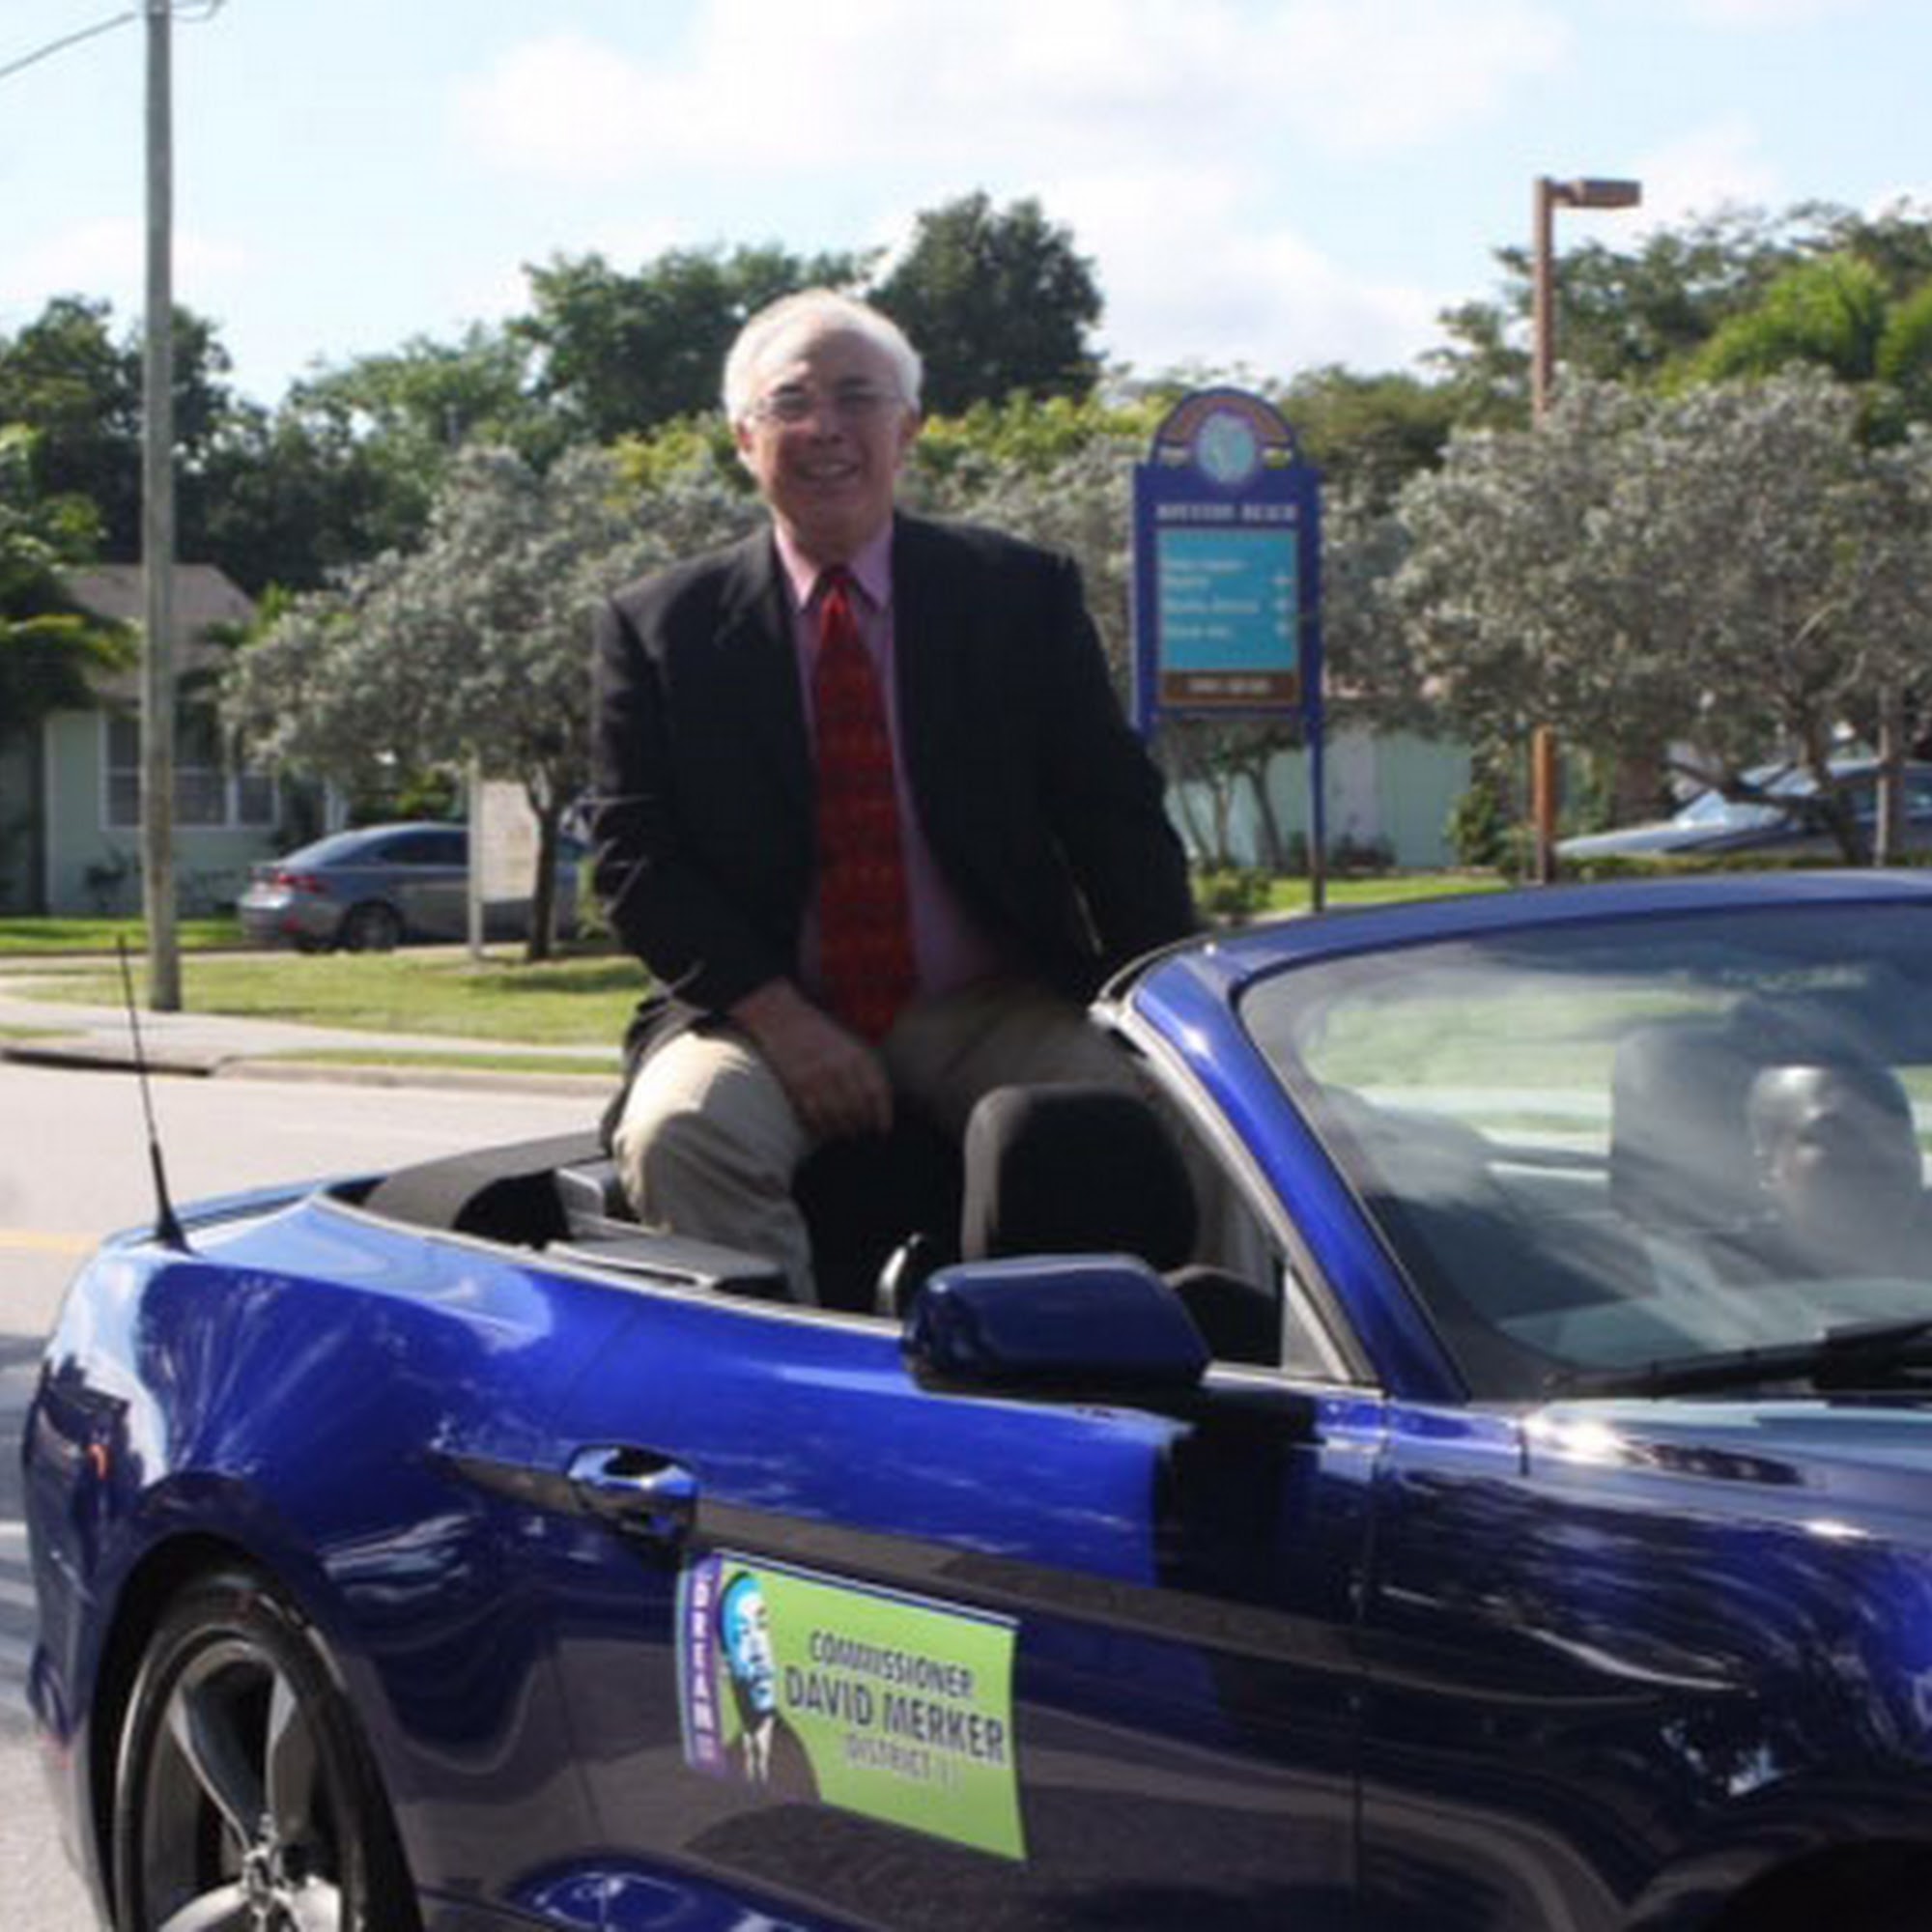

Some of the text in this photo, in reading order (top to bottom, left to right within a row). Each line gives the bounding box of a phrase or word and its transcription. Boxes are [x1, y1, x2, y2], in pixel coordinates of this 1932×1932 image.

[810, 1630, 972, 1697] COMMISSIONER
[783, 1664, 1005, 1761] DAVID MERKER
[846, 1732, 931, 1780] DISTRICT
